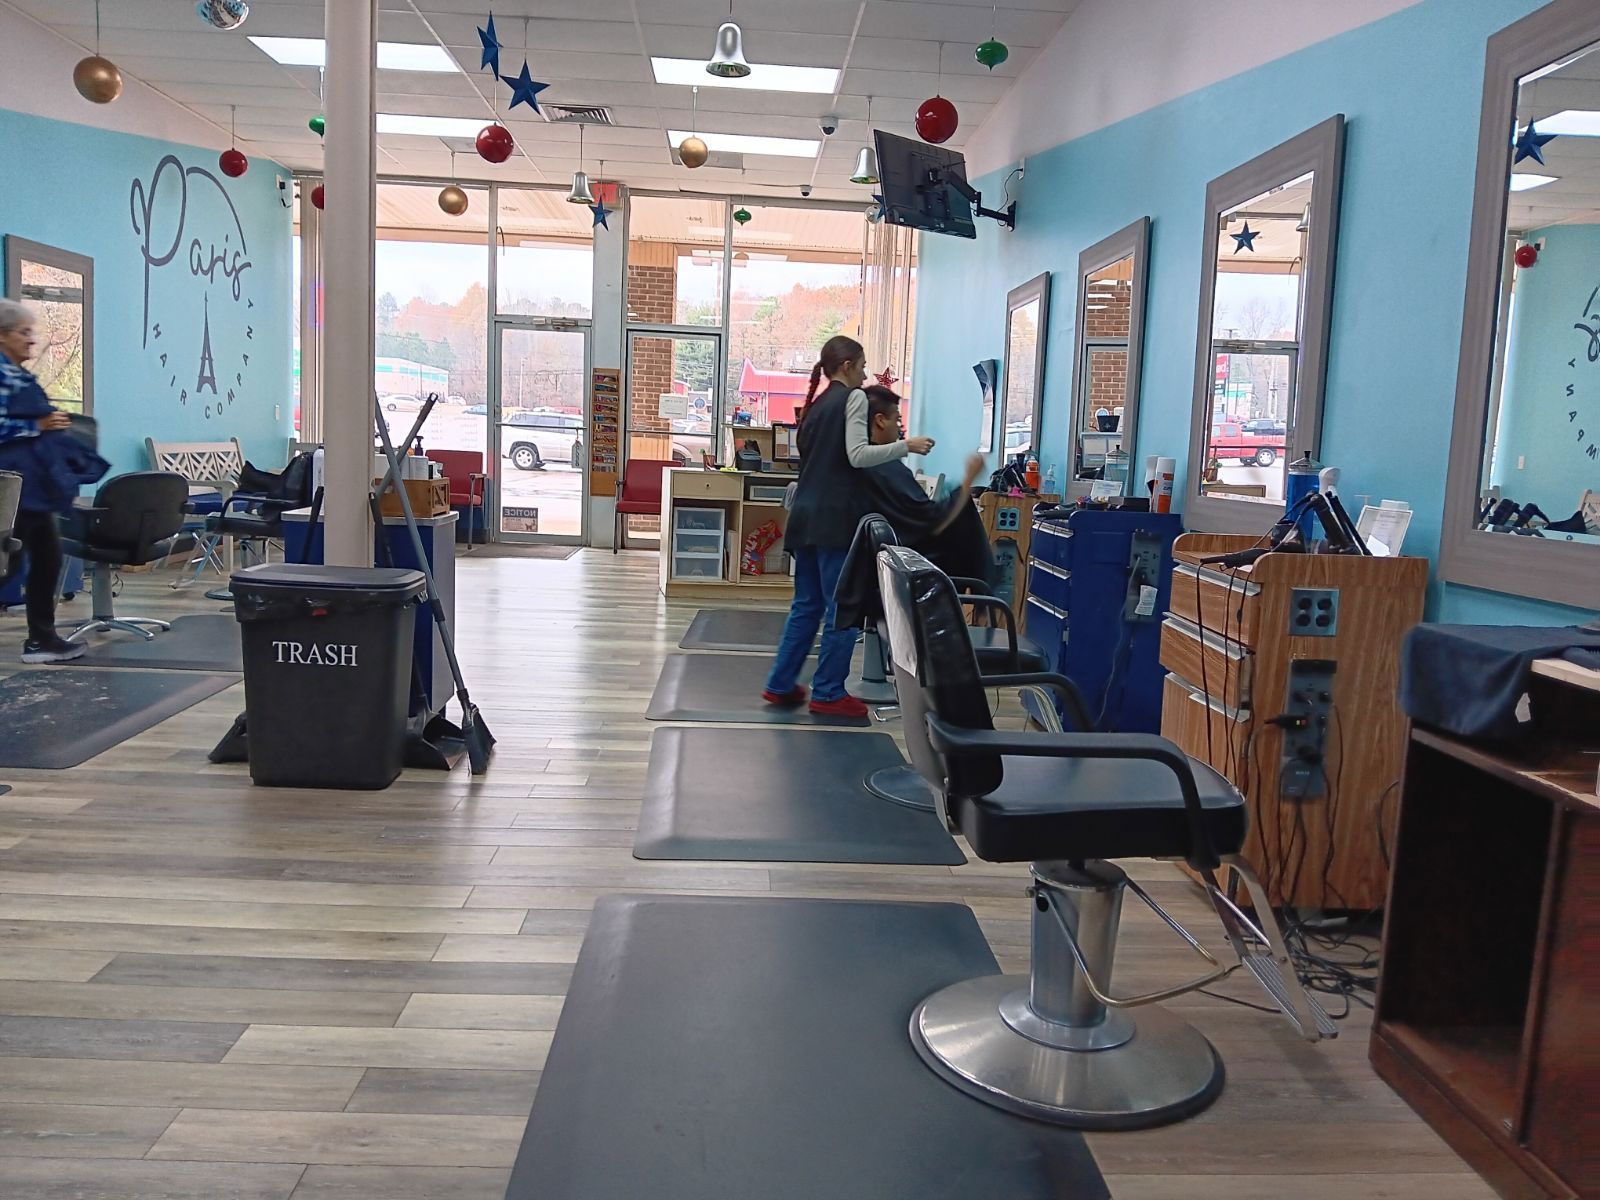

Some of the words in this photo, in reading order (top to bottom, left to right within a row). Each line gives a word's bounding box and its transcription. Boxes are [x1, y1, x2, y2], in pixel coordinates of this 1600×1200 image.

[130, 154, 251, 350] Paris
[152, 322, 187, 405] HAIR
[204, 298, 254, 420] COMPANY
[272, 640, 359, 667] TRASH
